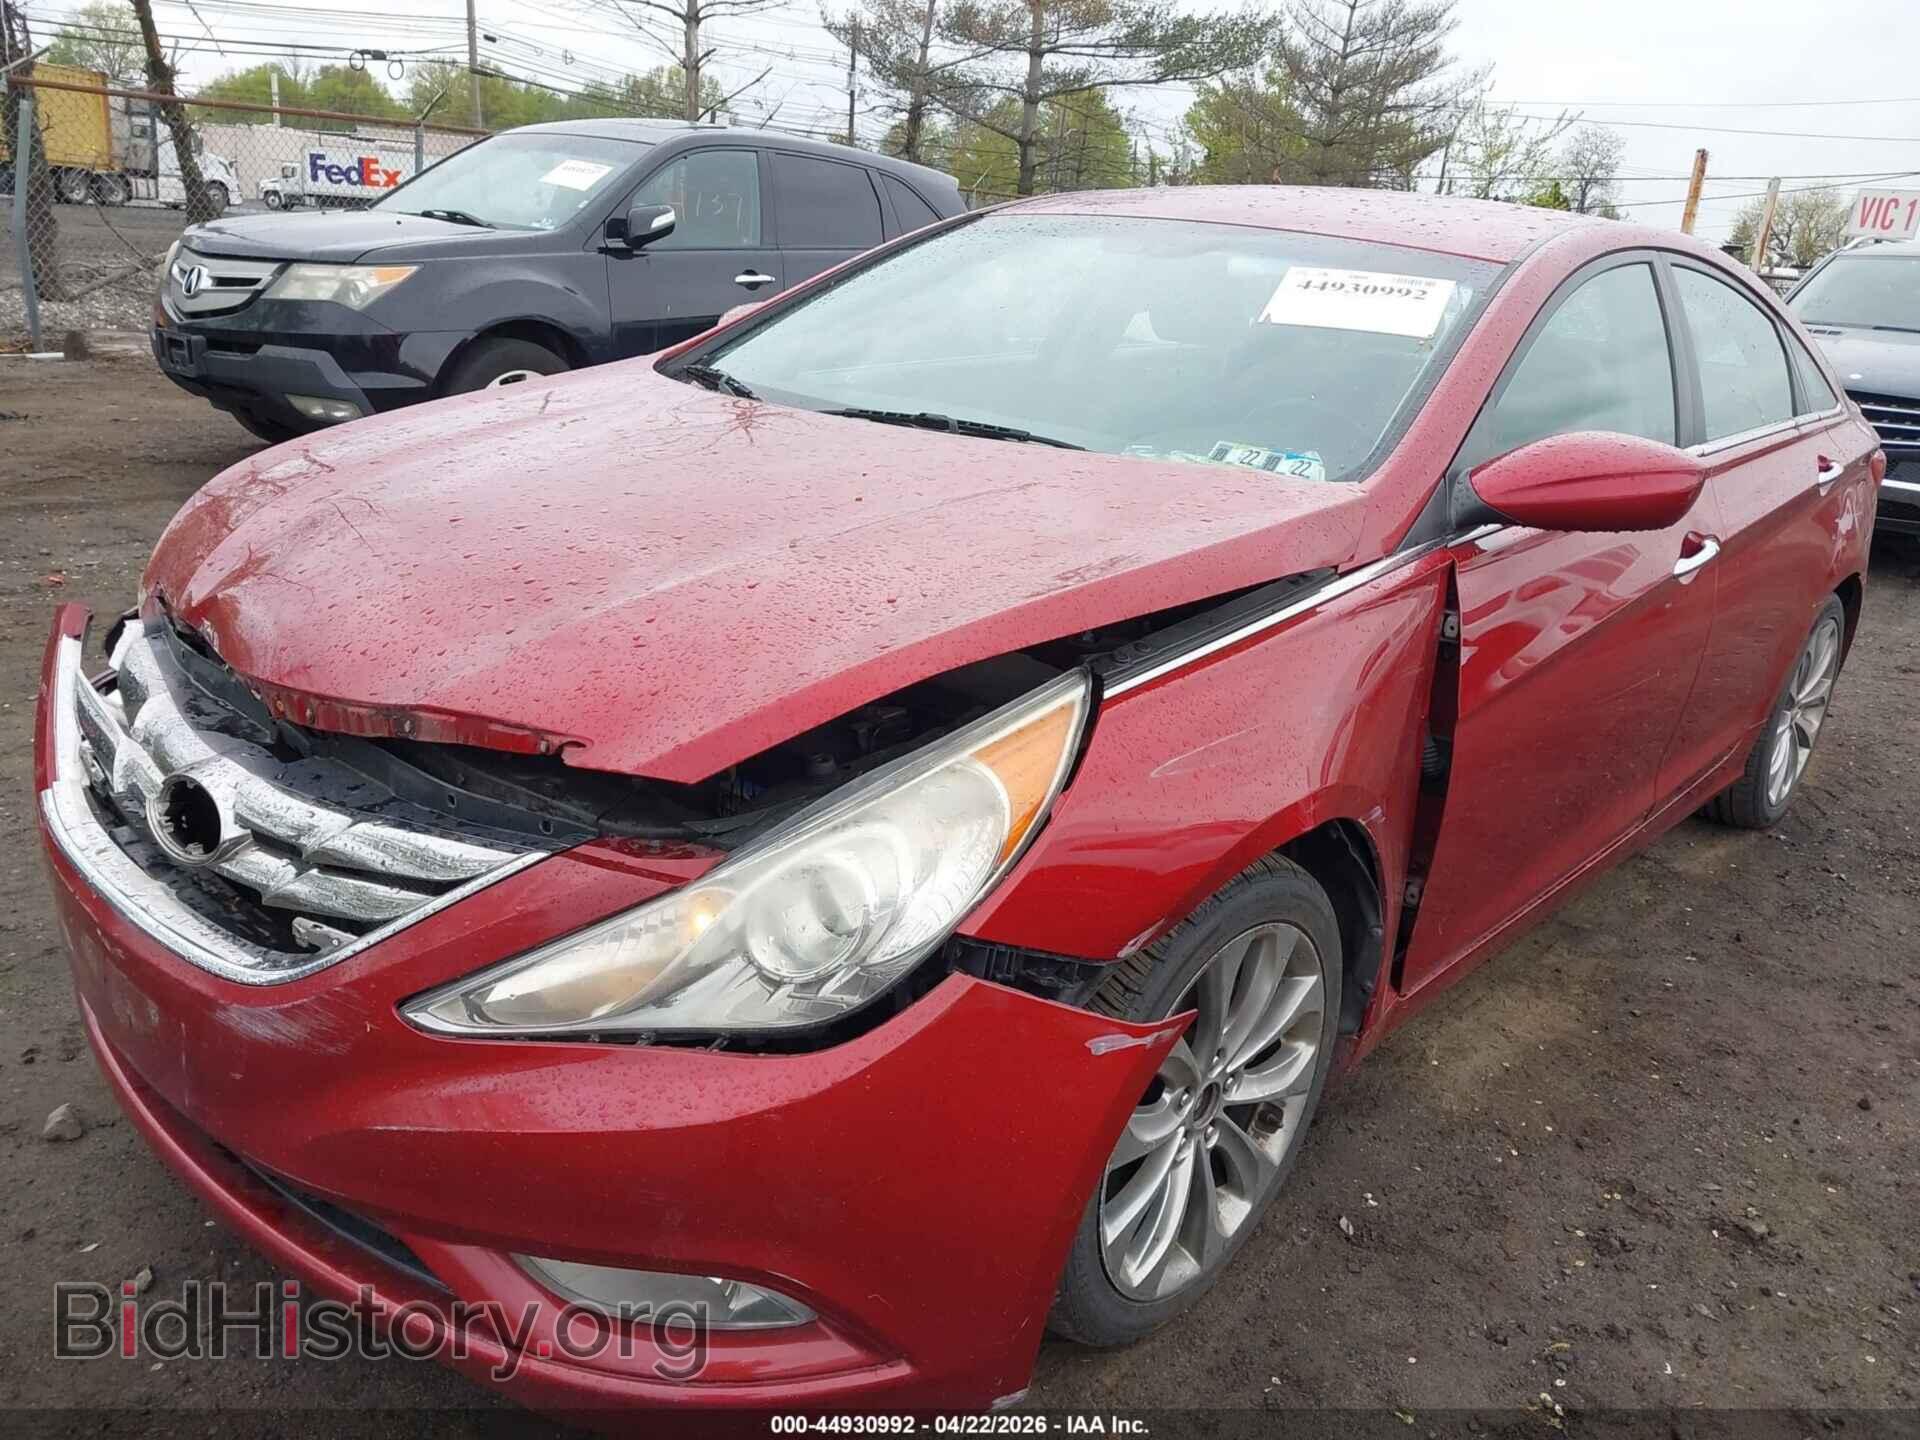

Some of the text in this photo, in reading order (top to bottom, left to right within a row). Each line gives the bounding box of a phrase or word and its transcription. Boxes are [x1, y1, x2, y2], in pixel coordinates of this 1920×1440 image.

[309, 153, 401, 187] FedEx
[1858, 196, 1918, 232] VIC 1
[1296, 279, 1428, 300] 44930992
[1239, 449, 1260, 466] 22
[1290, 460, 1312, 477] 22
